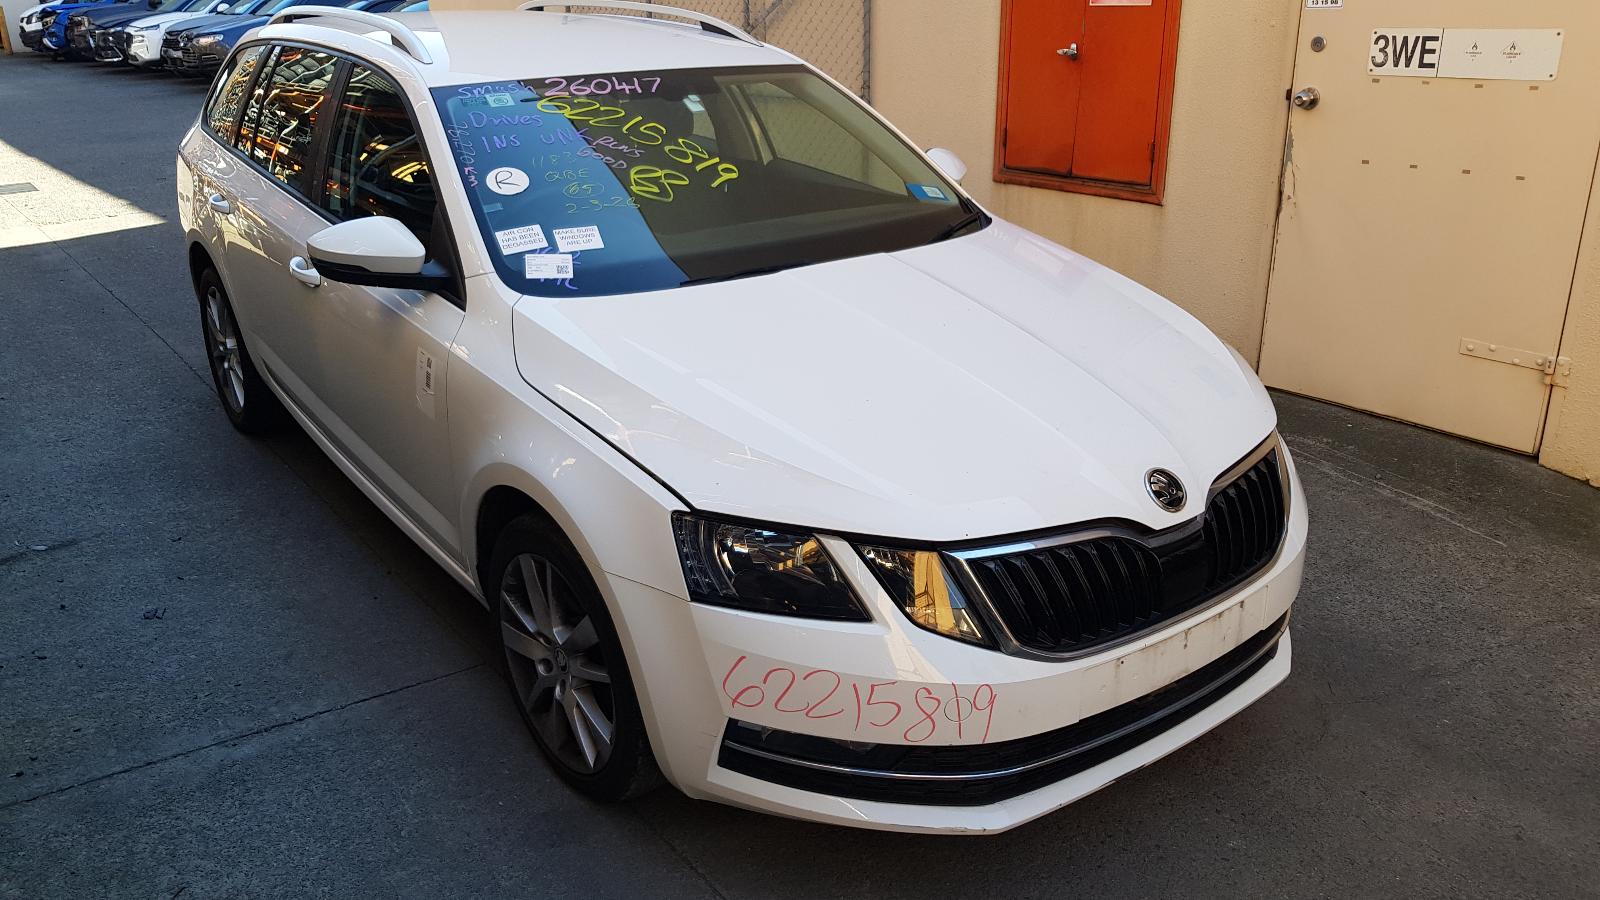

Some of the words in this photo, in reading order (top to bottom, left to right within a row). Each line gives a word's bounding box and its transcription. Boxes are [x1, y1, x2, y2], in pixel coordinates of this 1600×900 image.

[1371, 34, 1440, 69] 3WE
[544, 76, 661, 97] 260417
[501, 235, 518, 243] HAS
[519, 232, 540, 240] BEEN
[554, 228, 575, 236] MAKE
[559, 232, 596, 241] WINDOWS
[502, 237, 544, 250] DEGASSED
[722, 655, 998, 744] 62215819
